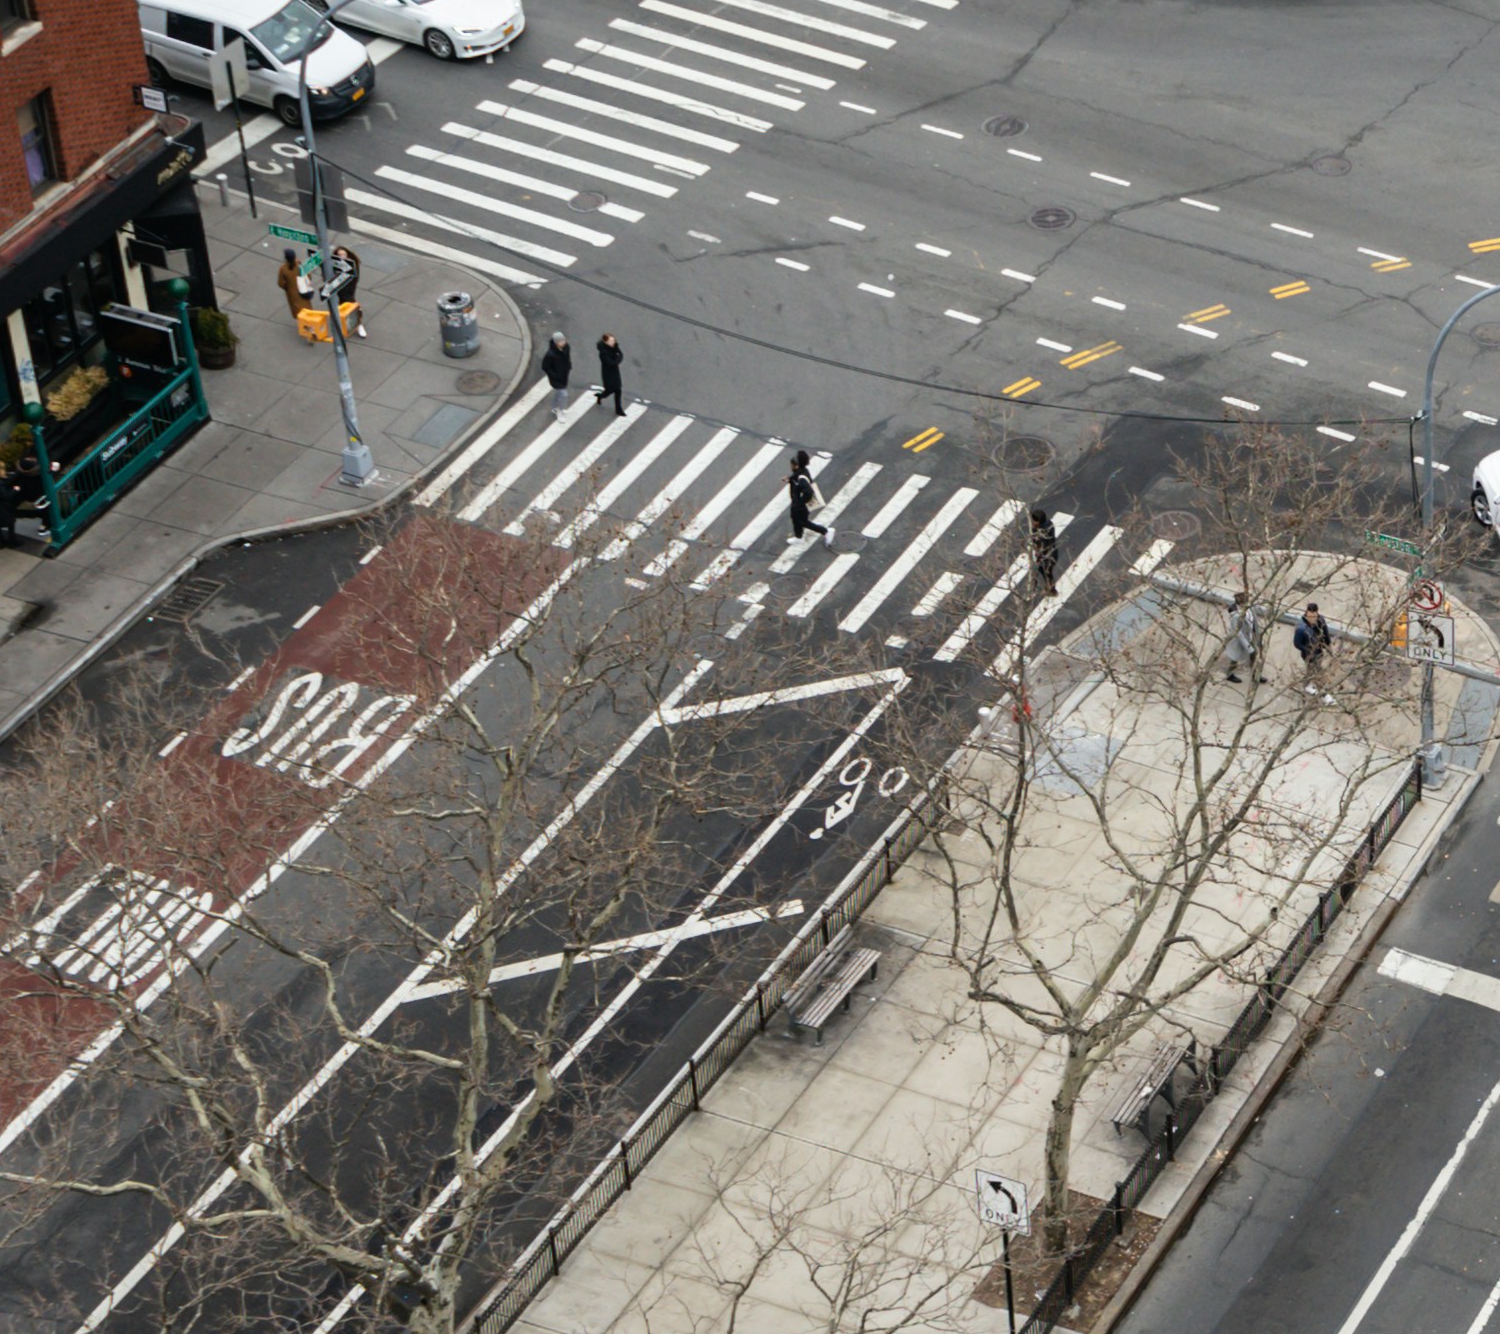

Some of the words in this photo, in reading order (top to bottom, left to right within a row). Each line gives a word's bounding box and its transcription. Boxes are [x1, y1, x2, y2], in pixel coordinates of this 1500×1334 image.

[101, 436, 128, 461] Subway
[1413, 646, 1448, 662] ONLY
[221, 671, 418, 789] BUS
